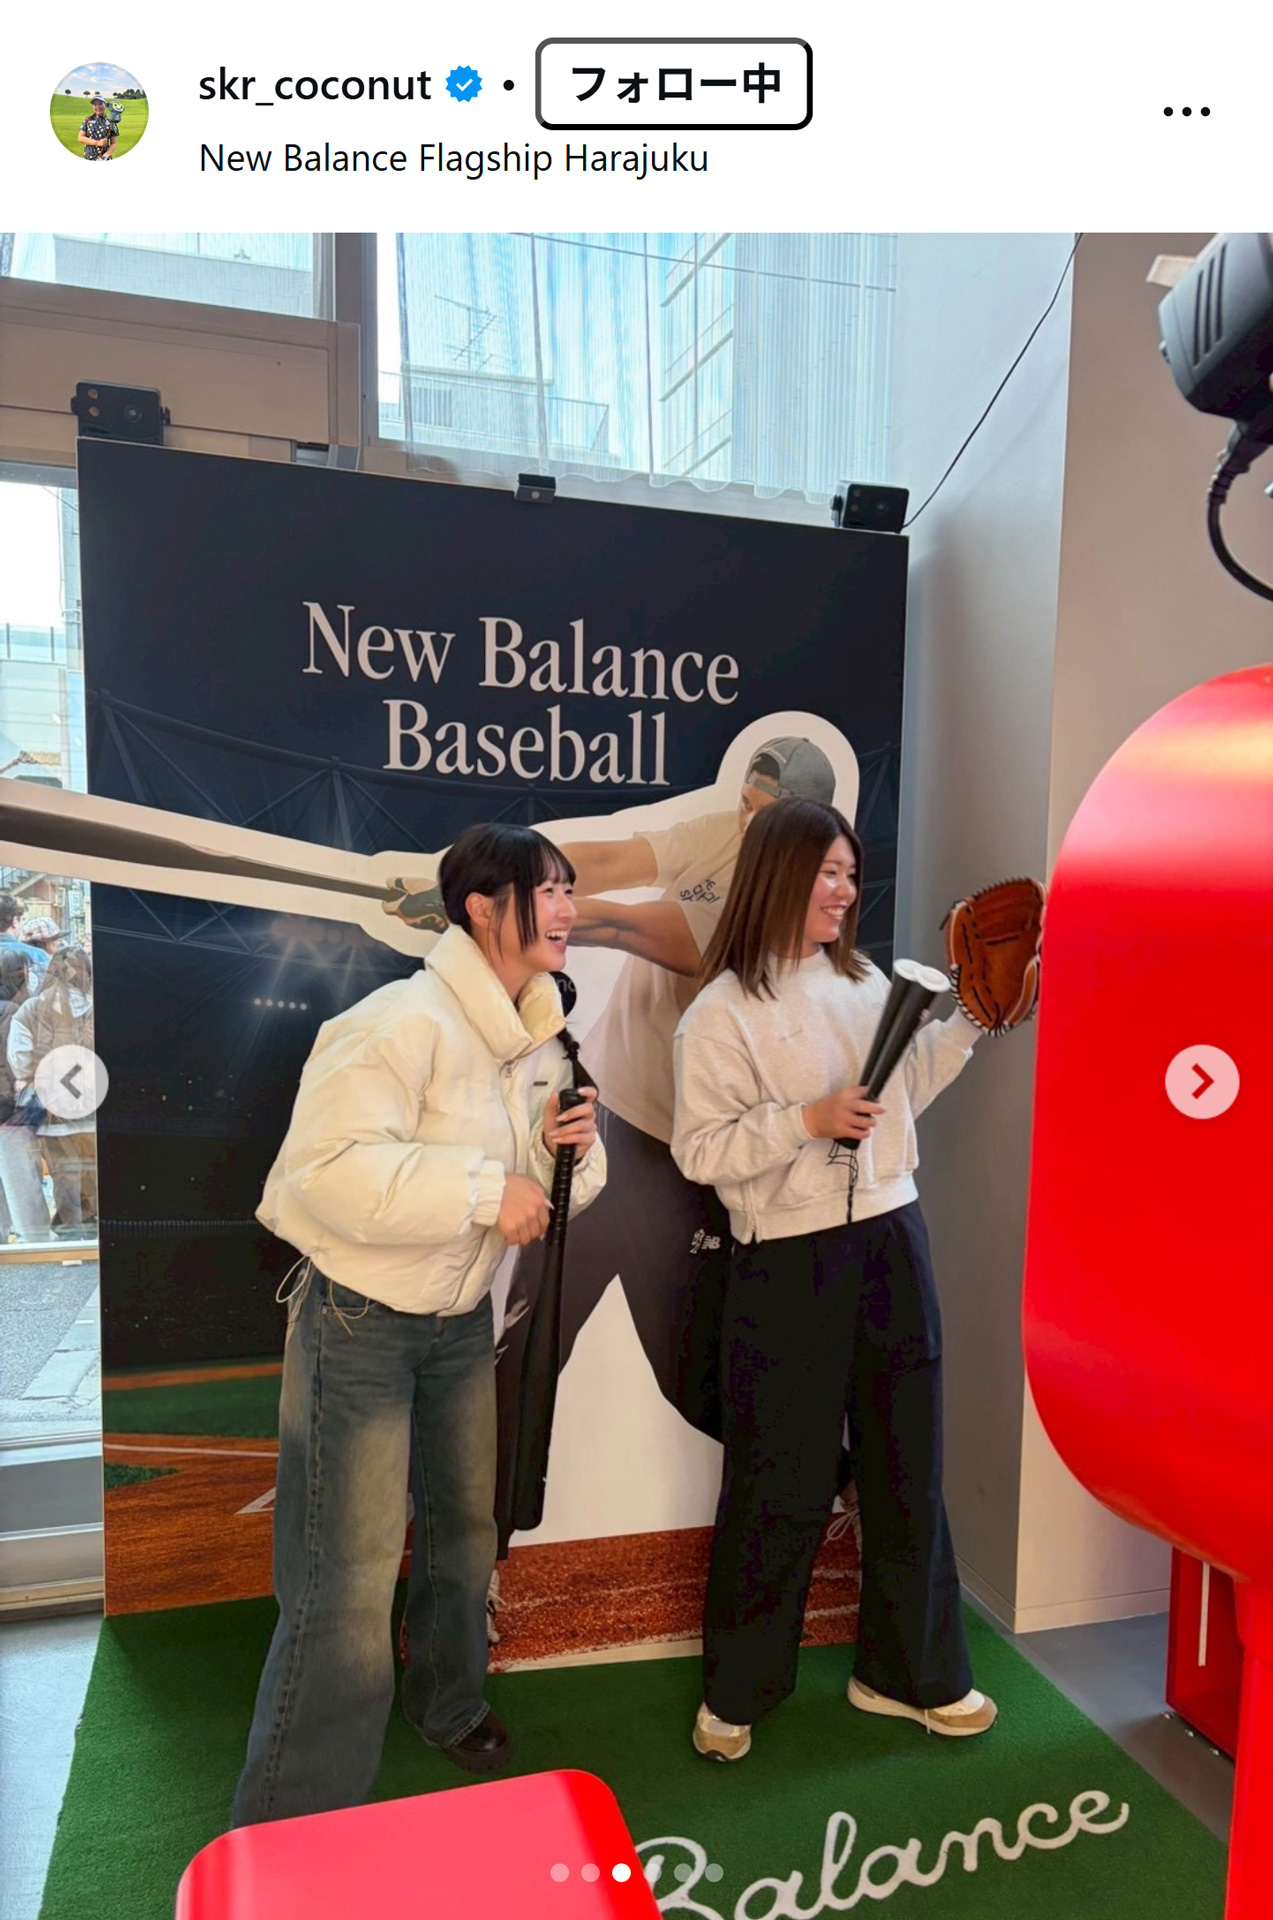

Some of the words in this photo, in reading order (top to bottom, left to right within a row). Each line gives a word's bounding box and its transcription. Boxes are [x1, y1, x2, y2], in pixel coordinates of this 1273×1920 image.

[302, 601, 457, 685] New
[479, 616, 740, 706] Balance
[382, 698, 671, 787] Baseball
[634, 1789, 1130, 1920] Balance
